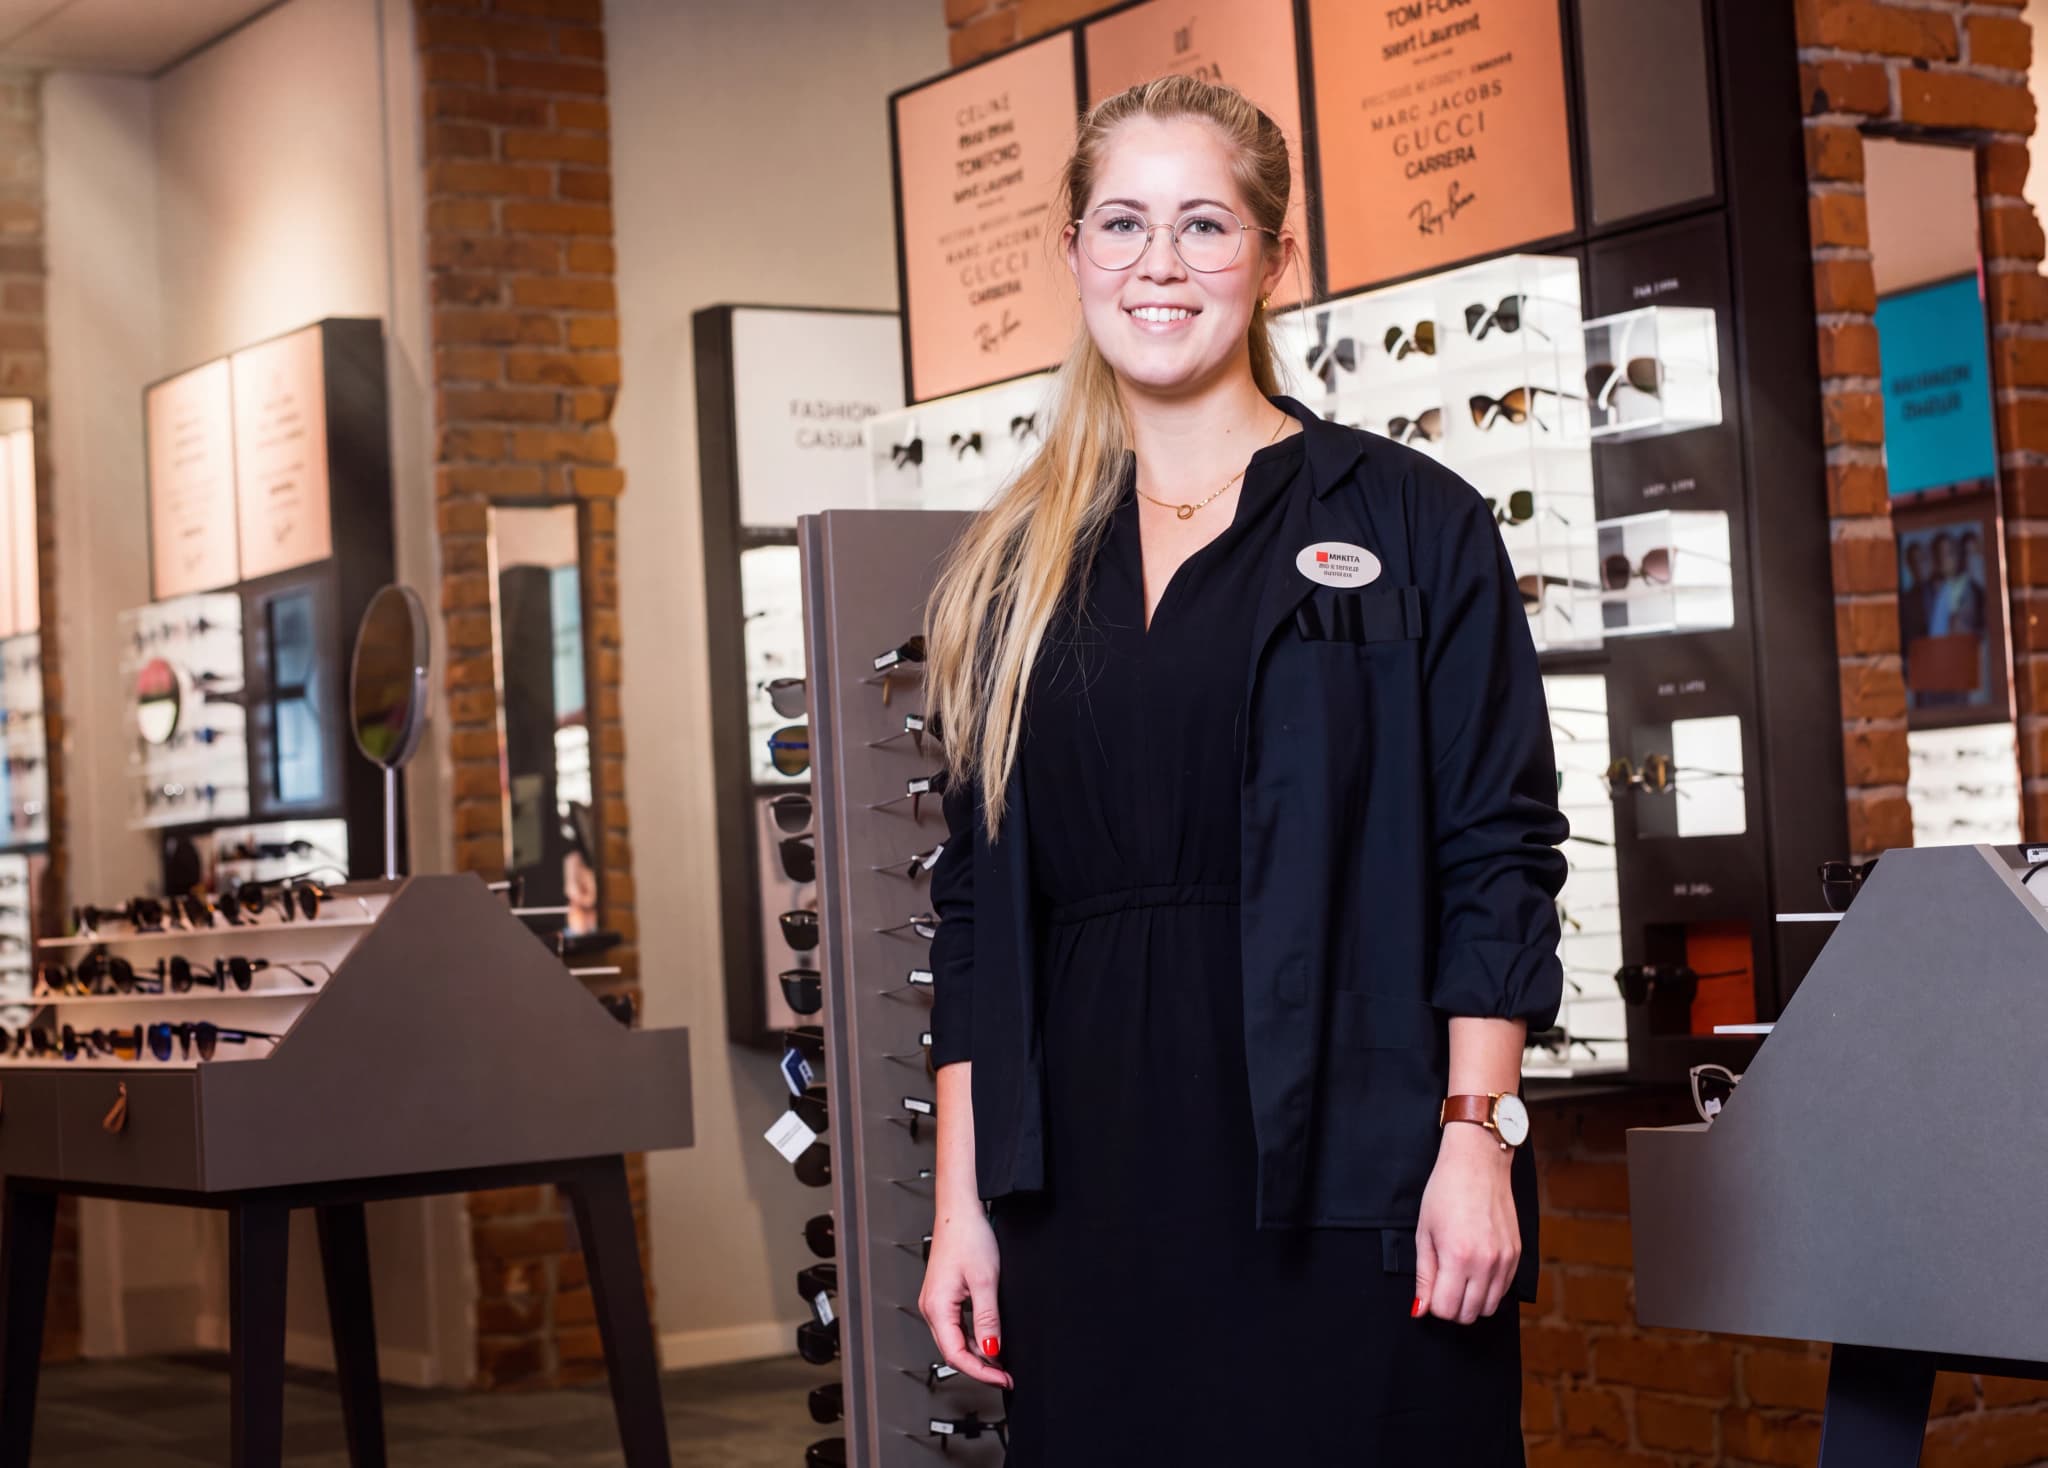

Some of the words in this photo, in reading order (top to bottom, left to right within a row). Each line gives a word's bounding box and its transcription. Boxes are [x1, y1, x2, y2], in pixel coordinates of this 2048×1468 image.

[1386, 1, 1422, 30] TOM
[1426, 0, 1472, 16] FO
[1371, 104, 1420, 132] MARC
[1429, 79, 1504, 117] JACOBS
[1393, 110, 1485, 157] GUCCI
[1405, 145, 1477, 179] CARRERA
[795, 429, 865, 449] CASUA
